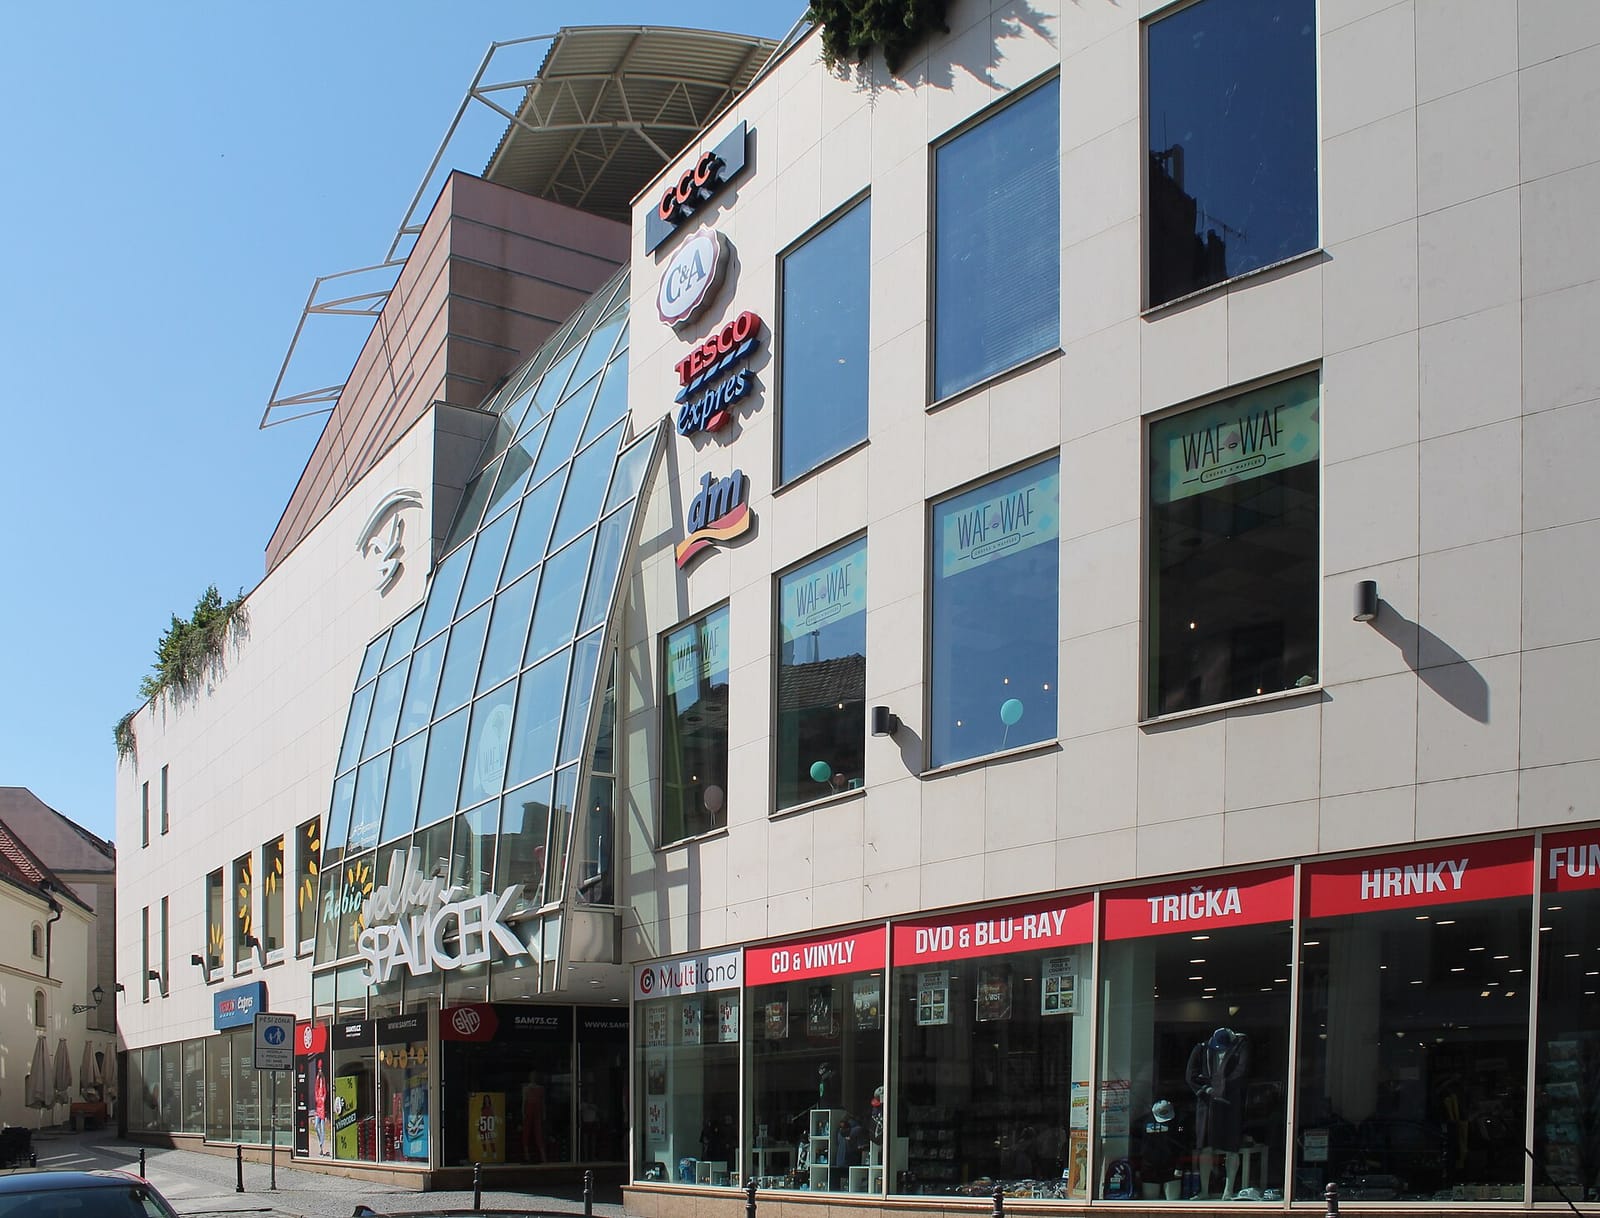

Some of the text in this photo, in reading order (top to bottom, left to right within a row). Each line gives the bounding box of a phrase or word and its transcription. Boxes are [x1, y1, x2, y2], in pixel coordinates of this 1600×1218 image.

[658, 151, 714, 221] CCC
[665, 249, 706, 304] C&A
[675, 311, 756, 386] TESCO
[676, 367, 748, 436] expres
[1182, 405, 1286, 473] WAF WAF
[687, 468, 743, 535] dm
[958, 487, 1036, 550] WAF WAF
[796, 577, 822, 618] WAF
[826, 562, 852, 604] WAF
[1147, 885, 1242, 924] TRIČKA
[1360, 858, 1469, 900] HRNKY
[771, 940, 855, 974] CD & VINYLY
[915, 908, 1067, 954] DVD & BLU-RAY
[659, 956, 737, 990] Multiland
[514, 1016, 558, 1025] SAM73.CZ
